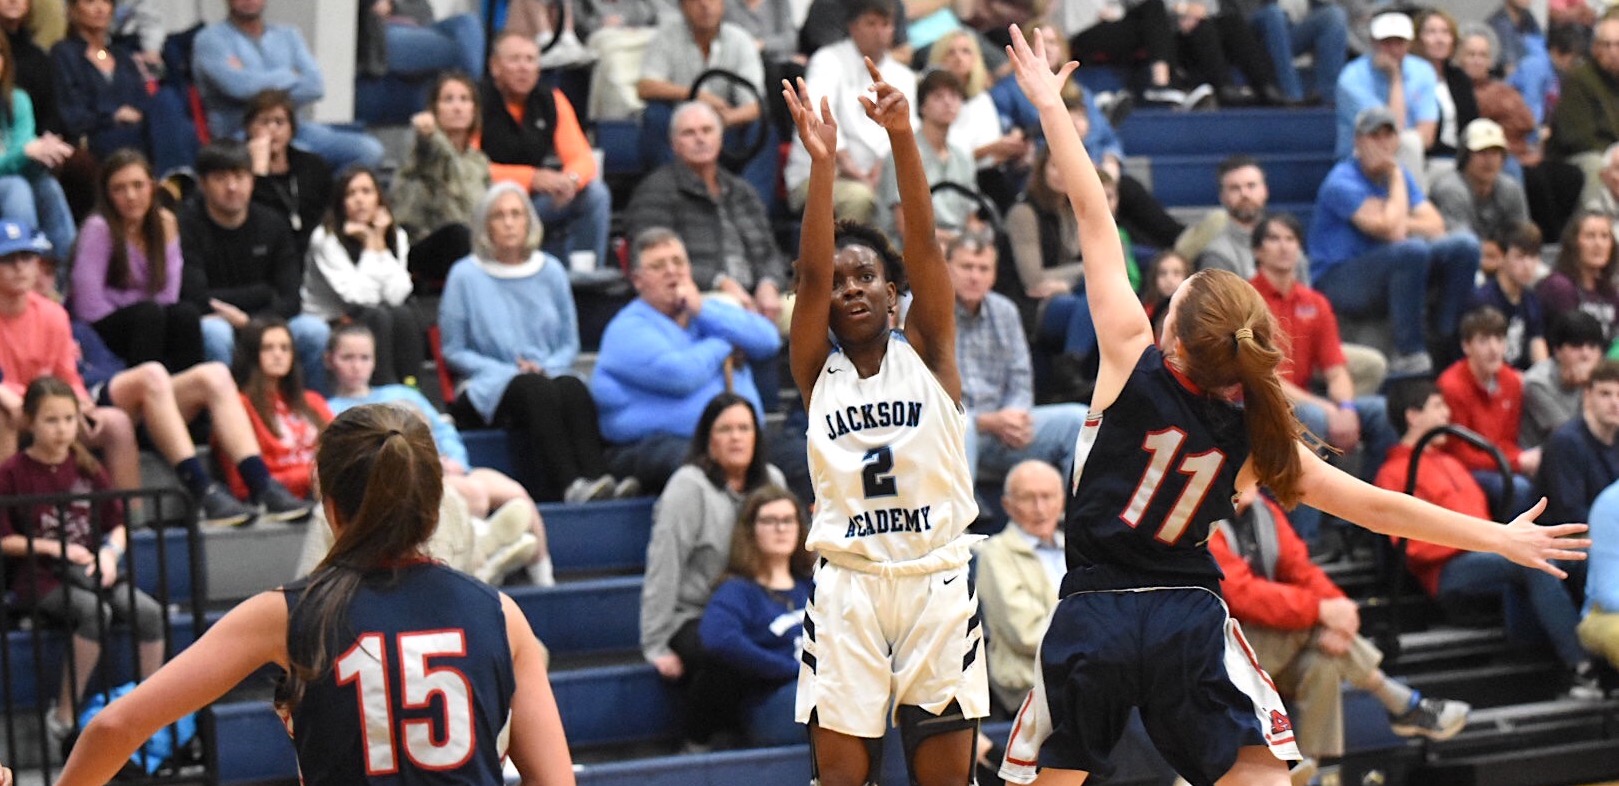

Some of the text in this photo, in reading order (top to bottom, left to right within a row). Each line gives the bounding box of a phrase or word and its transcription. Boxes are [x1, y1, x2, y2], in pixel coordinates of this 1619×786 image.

[826, 401, 922, 440] JACKSON
[861, 445, 899, 499] 2
[1119, 425, 1227, 547] 11
[845, 505, 931, 538] ACADEMY
[334, 627, 476, 776] 15
